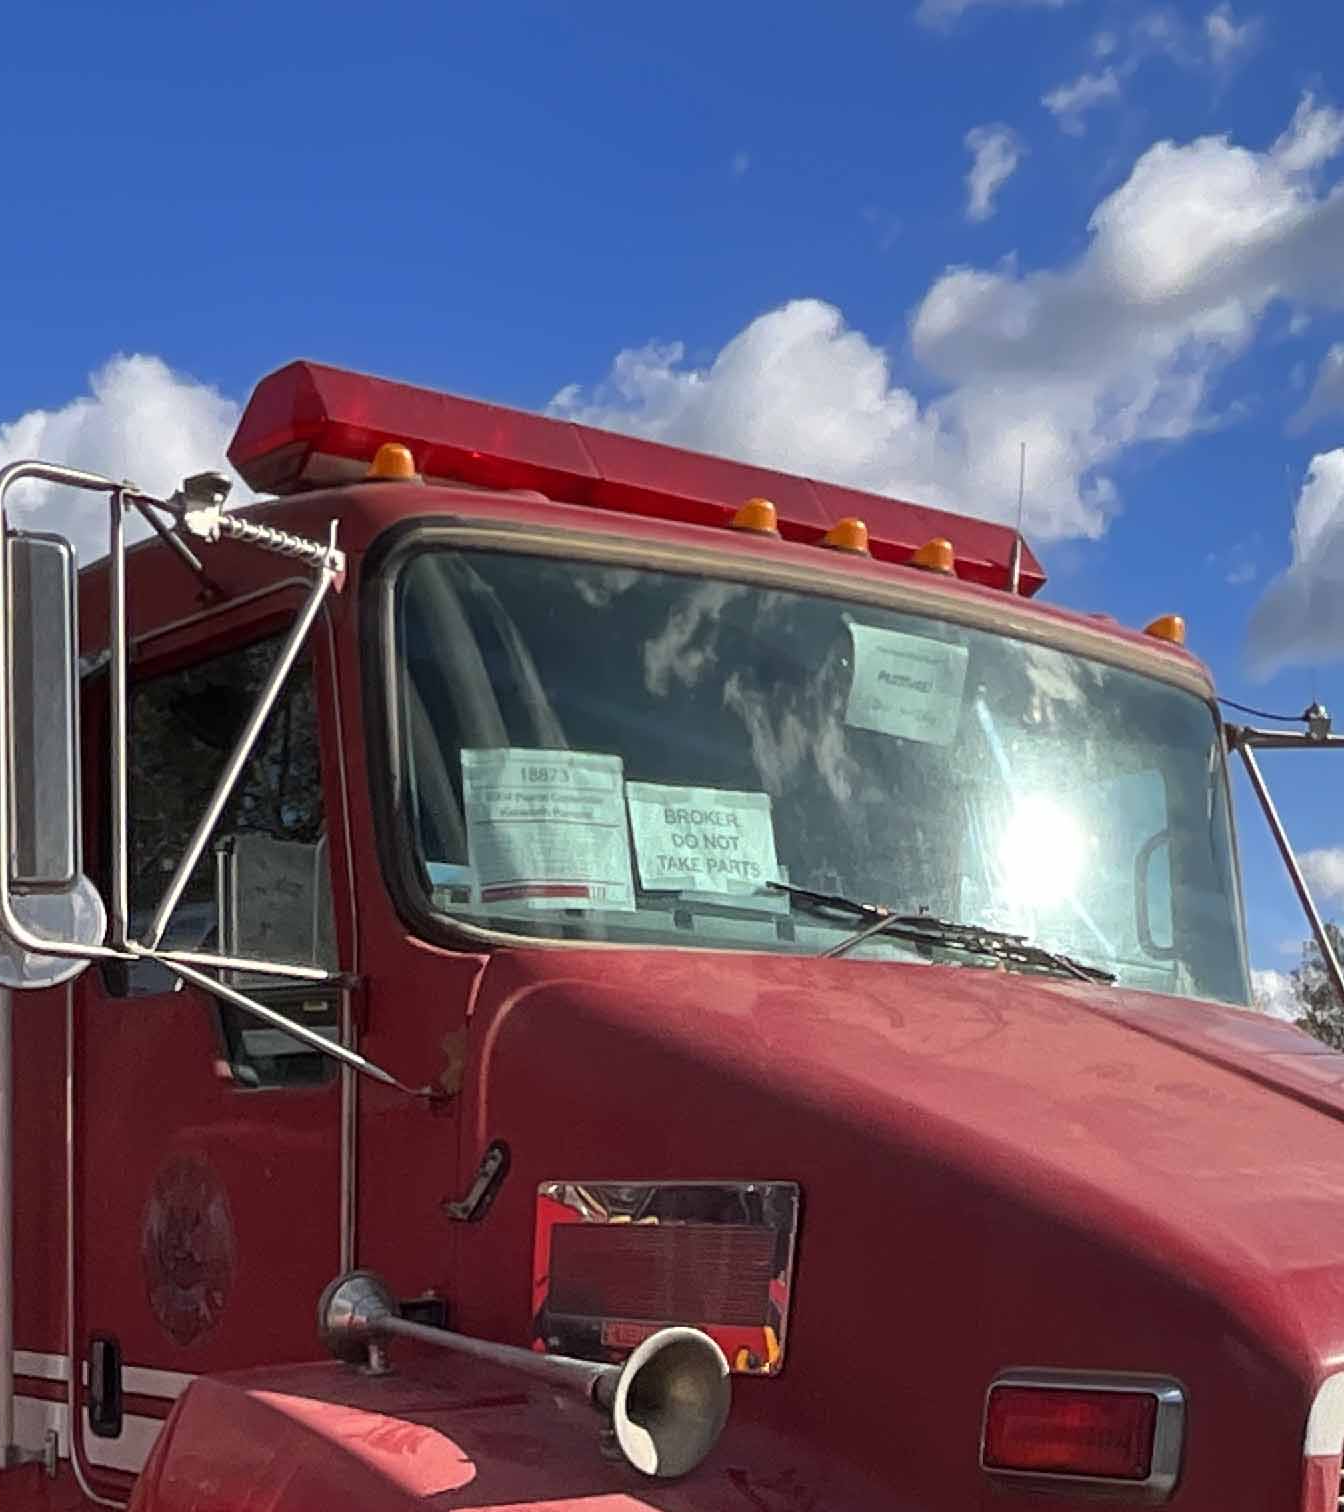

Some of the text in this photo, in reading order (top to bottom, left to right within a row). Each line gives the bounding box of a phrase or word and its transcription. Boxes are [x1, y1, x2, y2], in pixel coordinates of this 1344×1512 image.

[664, 808, 739, 828] BROKER
[672, 833, 740, 850] DO NOT
[656, 855, 761, 878] TAKE PARTS
